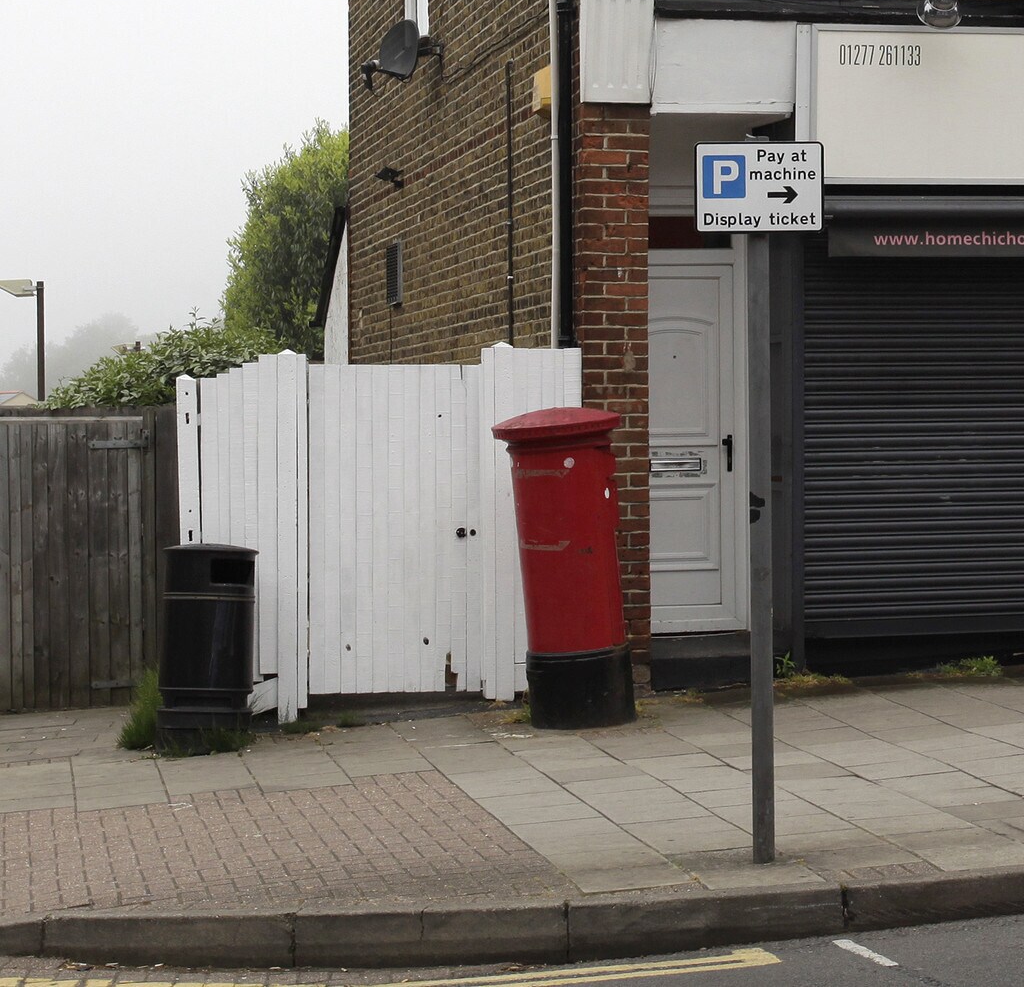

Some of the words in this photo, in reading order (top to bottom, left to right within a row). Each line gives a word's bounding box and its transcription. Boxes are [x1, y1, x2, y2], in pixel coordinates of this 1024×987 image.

[839, 43, 875, 66] 01277
[878, 44, 921, 67] 261133
[757, 149, 785, 165] Pay
[791, 149, 807, 162] at
[713, 160, 740, 195] P
[749, 167, 816, 181] machine
[703, 213, 762, 228] Display
[769, 213, 816, 225] ticket
